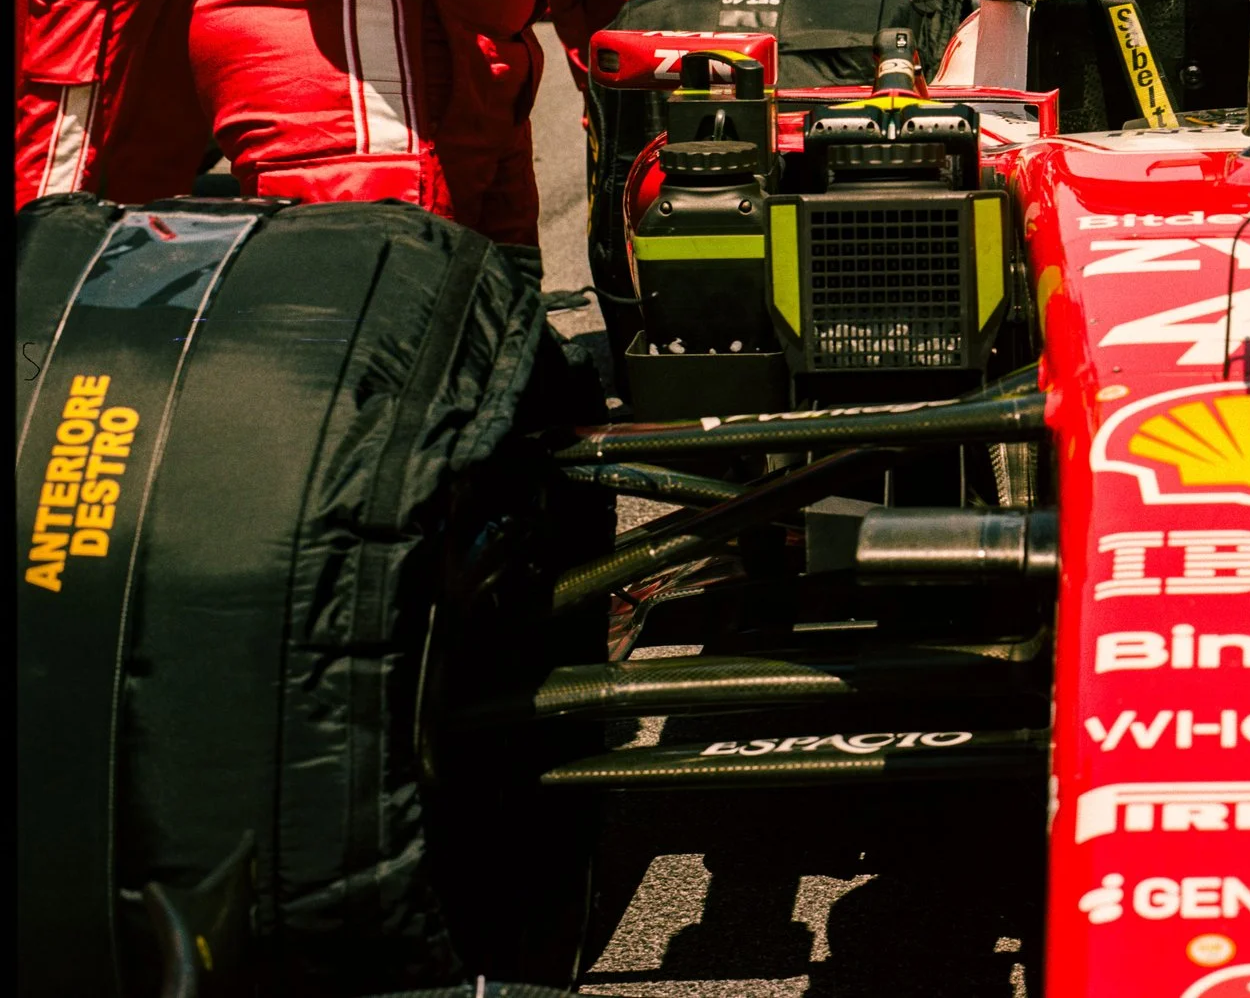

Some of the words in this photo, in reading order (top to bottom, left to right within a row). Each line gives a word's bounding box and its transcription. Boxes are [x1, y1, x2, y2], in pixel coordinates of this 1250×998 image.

[653, 49, 734, 81] ZN
[1116, 8, 1168, 128] Sabelt
[24, 374, 111, 592] ANTERIORE
[69, 405, 140, 557] DESTRO
[700, 731, 973, 757] ESPACIO
